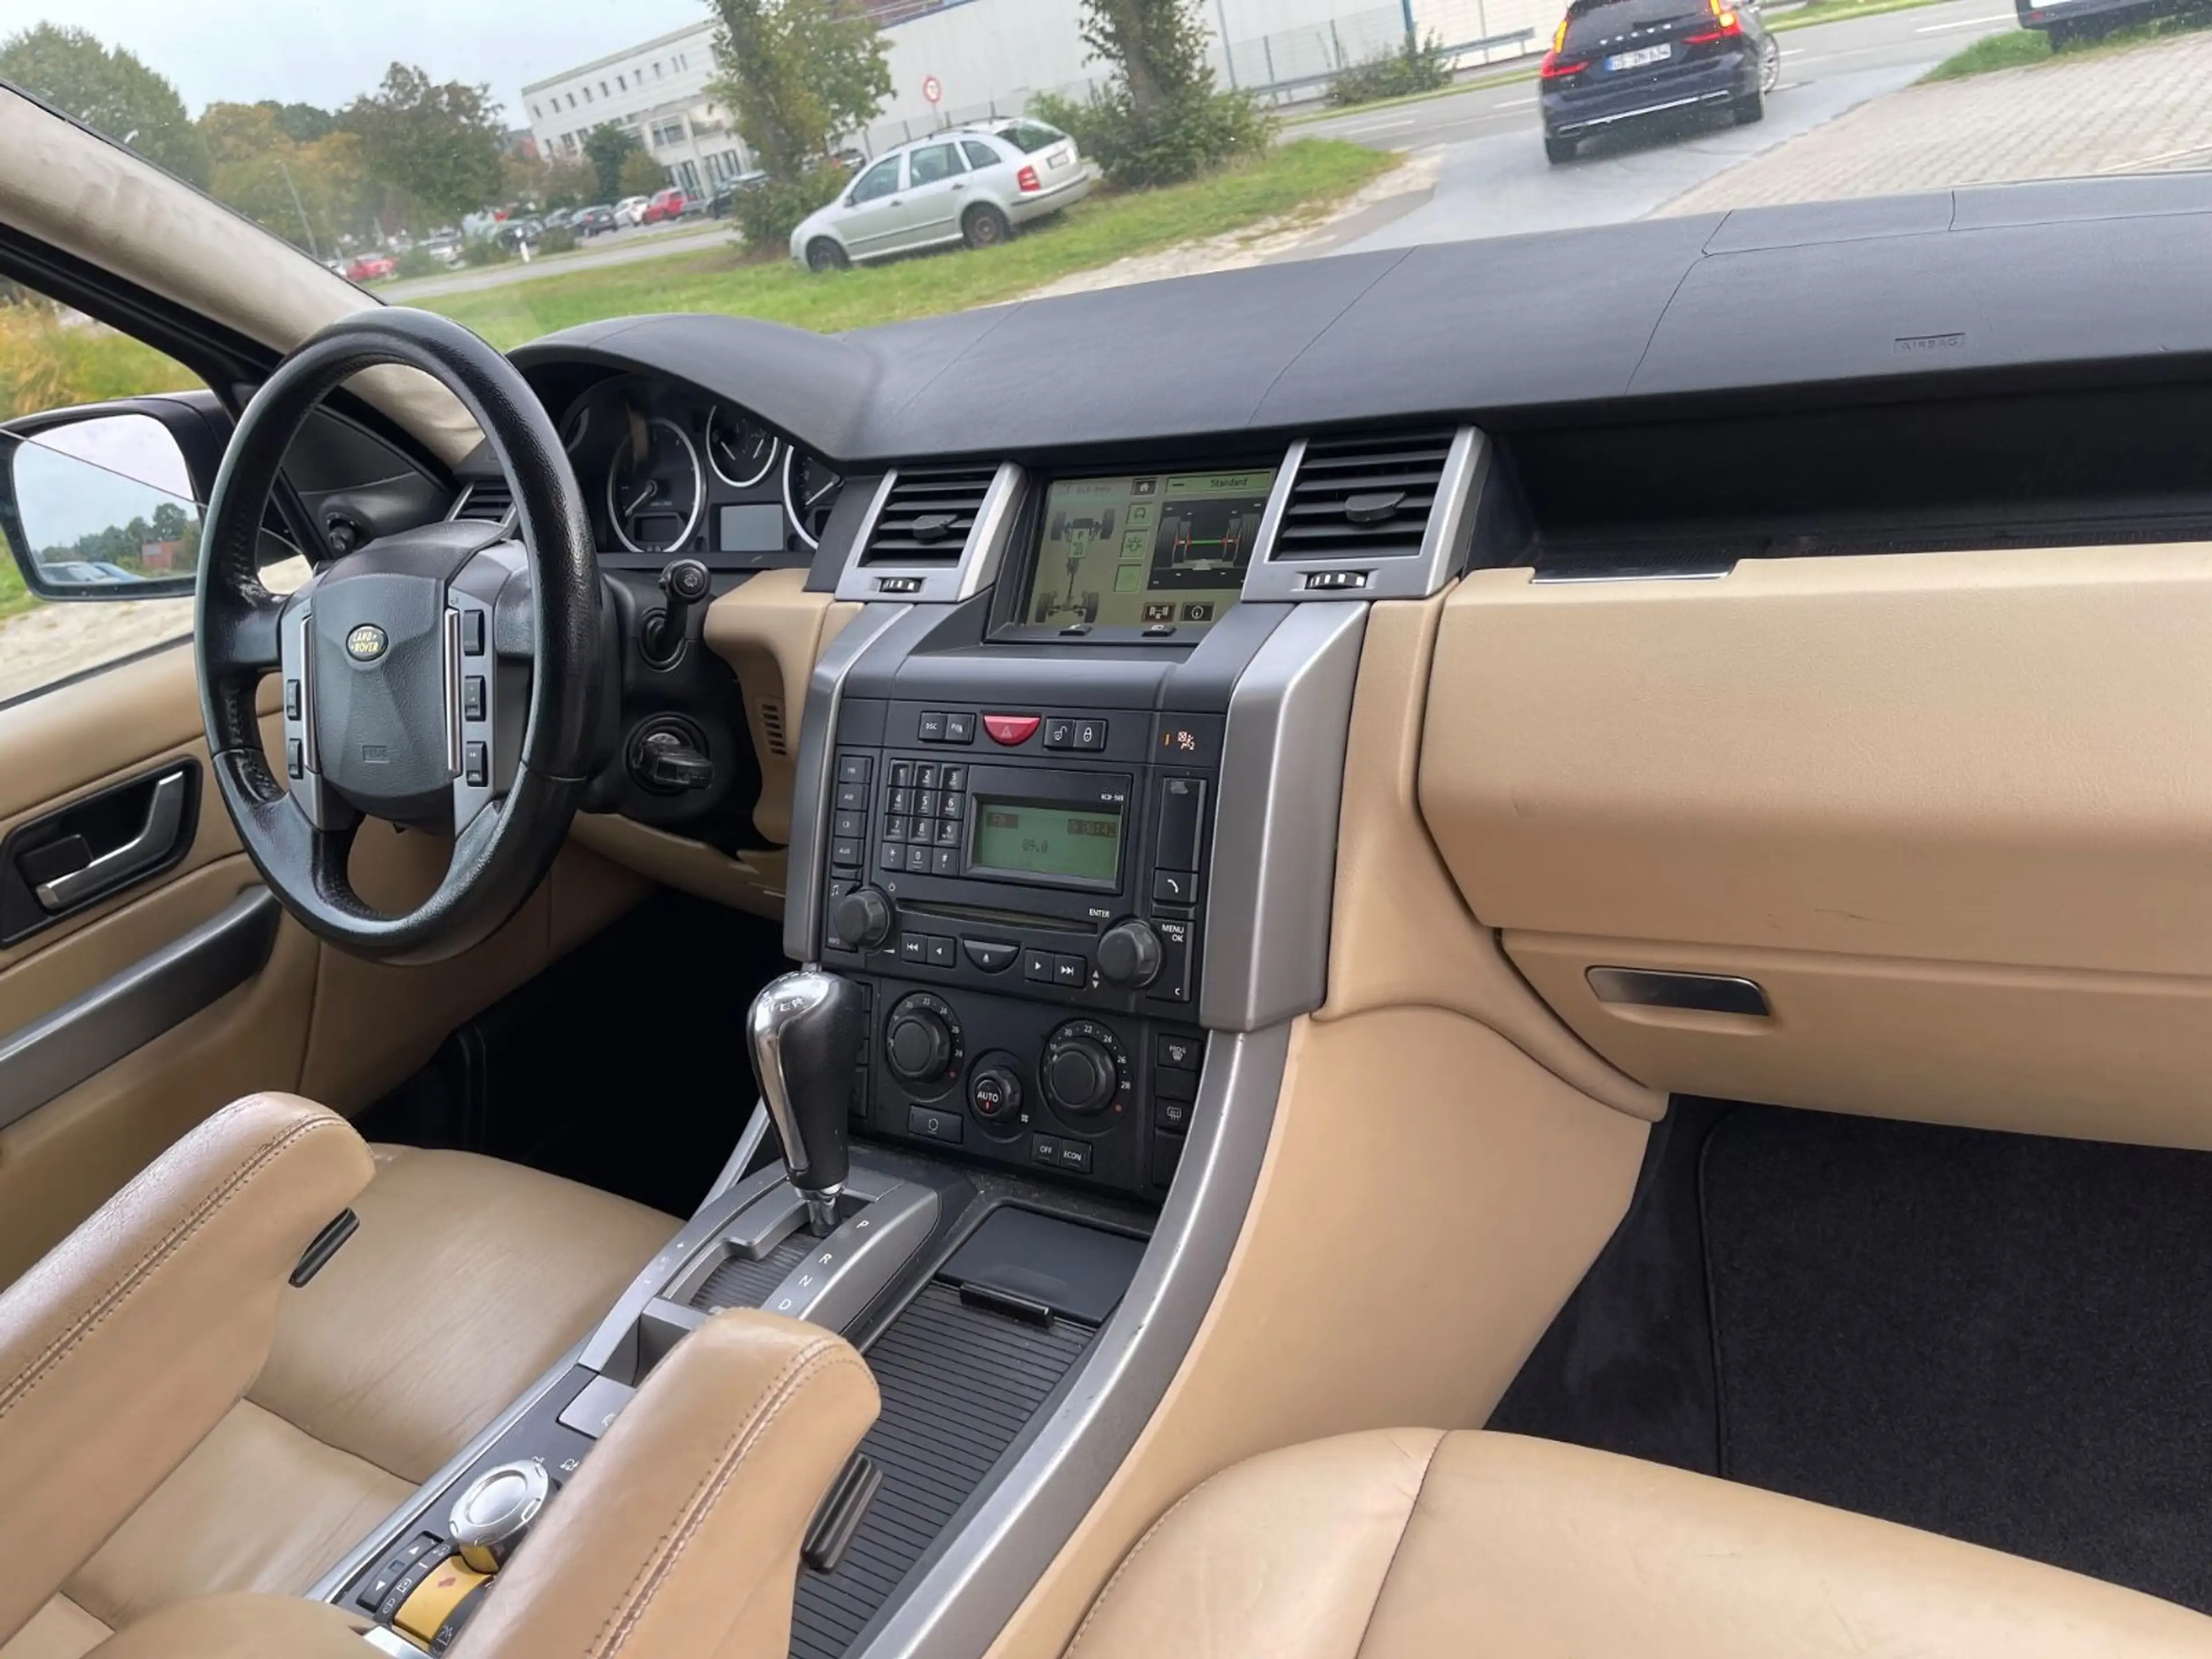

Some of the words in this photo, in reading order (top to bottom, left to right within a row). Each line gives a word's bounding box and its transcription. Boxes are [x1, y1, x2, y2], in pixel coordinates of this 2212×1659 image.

[1902, 338, 1957, 351] AIRBAG
[1210, 477, 1248, 487] Standard
[352, 631, 373, 642] LAND
[354, 641, 378, 653] ROVER
[895, 794, 902, 803] 4
[922, 796, 928, 805] 5
[948, 797, 954, 807] 6
[894, 820, 900, 829] 7
[919, 822, 925, 832] 8
[915, 851, 921, 861] 0
[1089, 908, 1110, 918] ENTER
[1161, 923, 1185, 933] MENU
[1172, 934, 1184, 942] OK
[1175, 987, 1181, 996] C
[1103, 1035, 1112, 1043] 24
[1117, 1055, 1127, 1065] 26
[977, 1092, 999, 1103] AUTO
[1039, 1145, 1052, 1154] OFF
[1063, 1151, 1082, 1161] ECON
[855, 1219, 870, 1229] P
[818, 1253, 832, 1265] R
[798, 1274, 813, 1287] N
[778, 1298, 792, 1310] D
